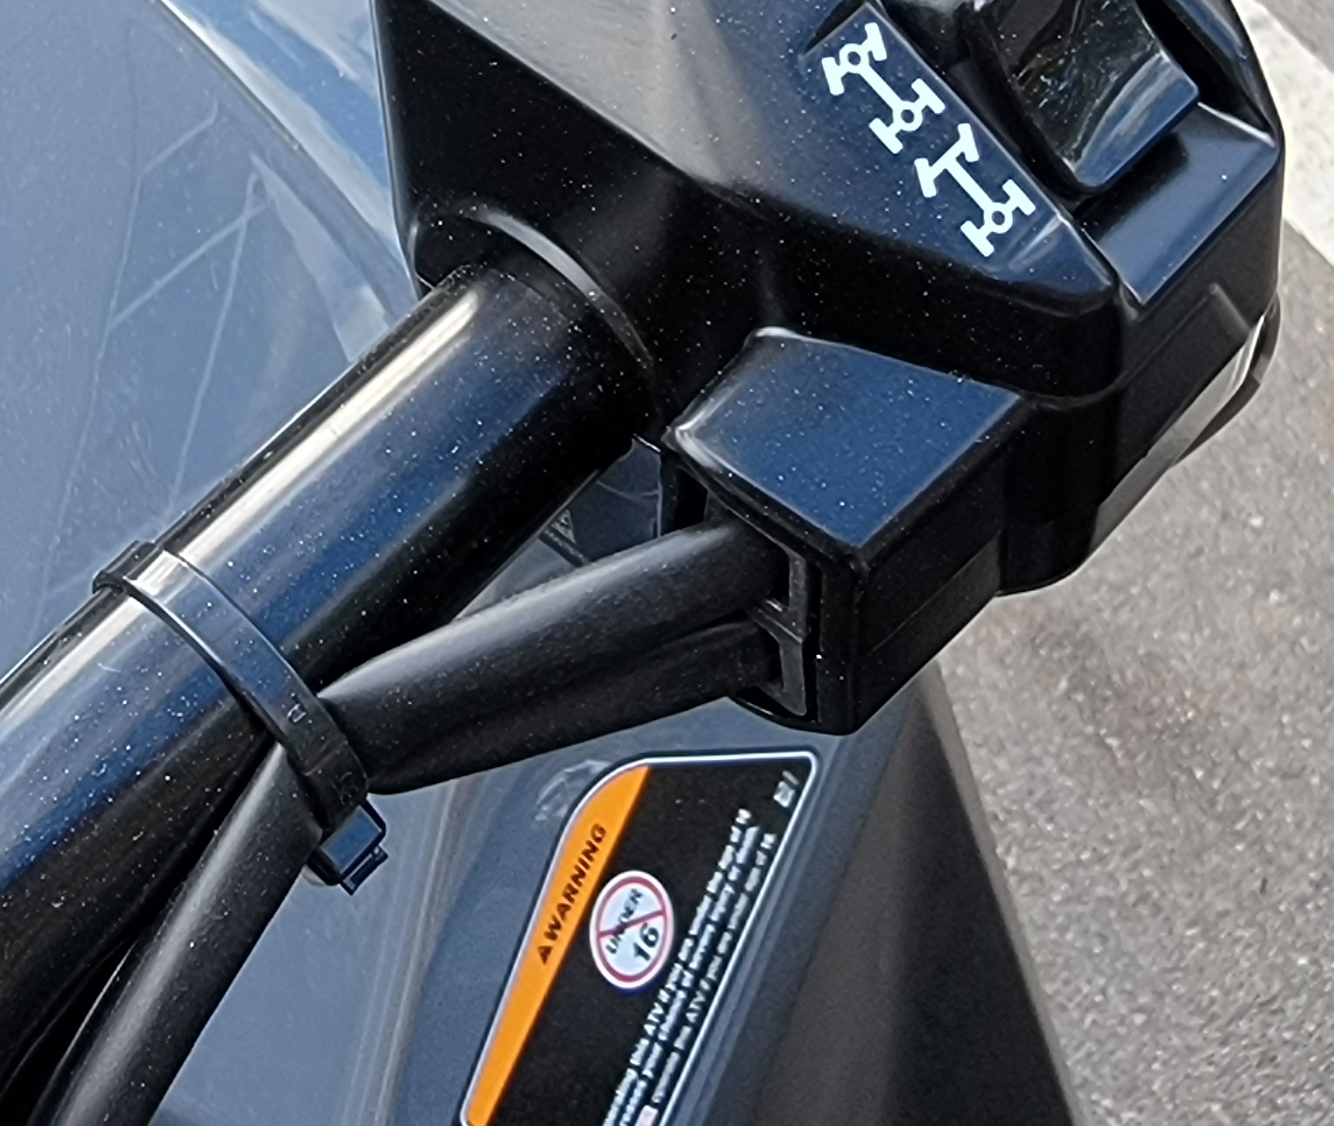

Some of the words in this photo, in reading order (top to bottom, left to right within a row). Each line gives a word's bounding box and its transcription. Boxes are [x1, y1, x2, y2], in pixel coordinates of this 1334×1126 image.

[543, 821, 608, 942] WARNING
[604, 887, 642, 955] UNDER
[631, 920, 660, 963] 16
